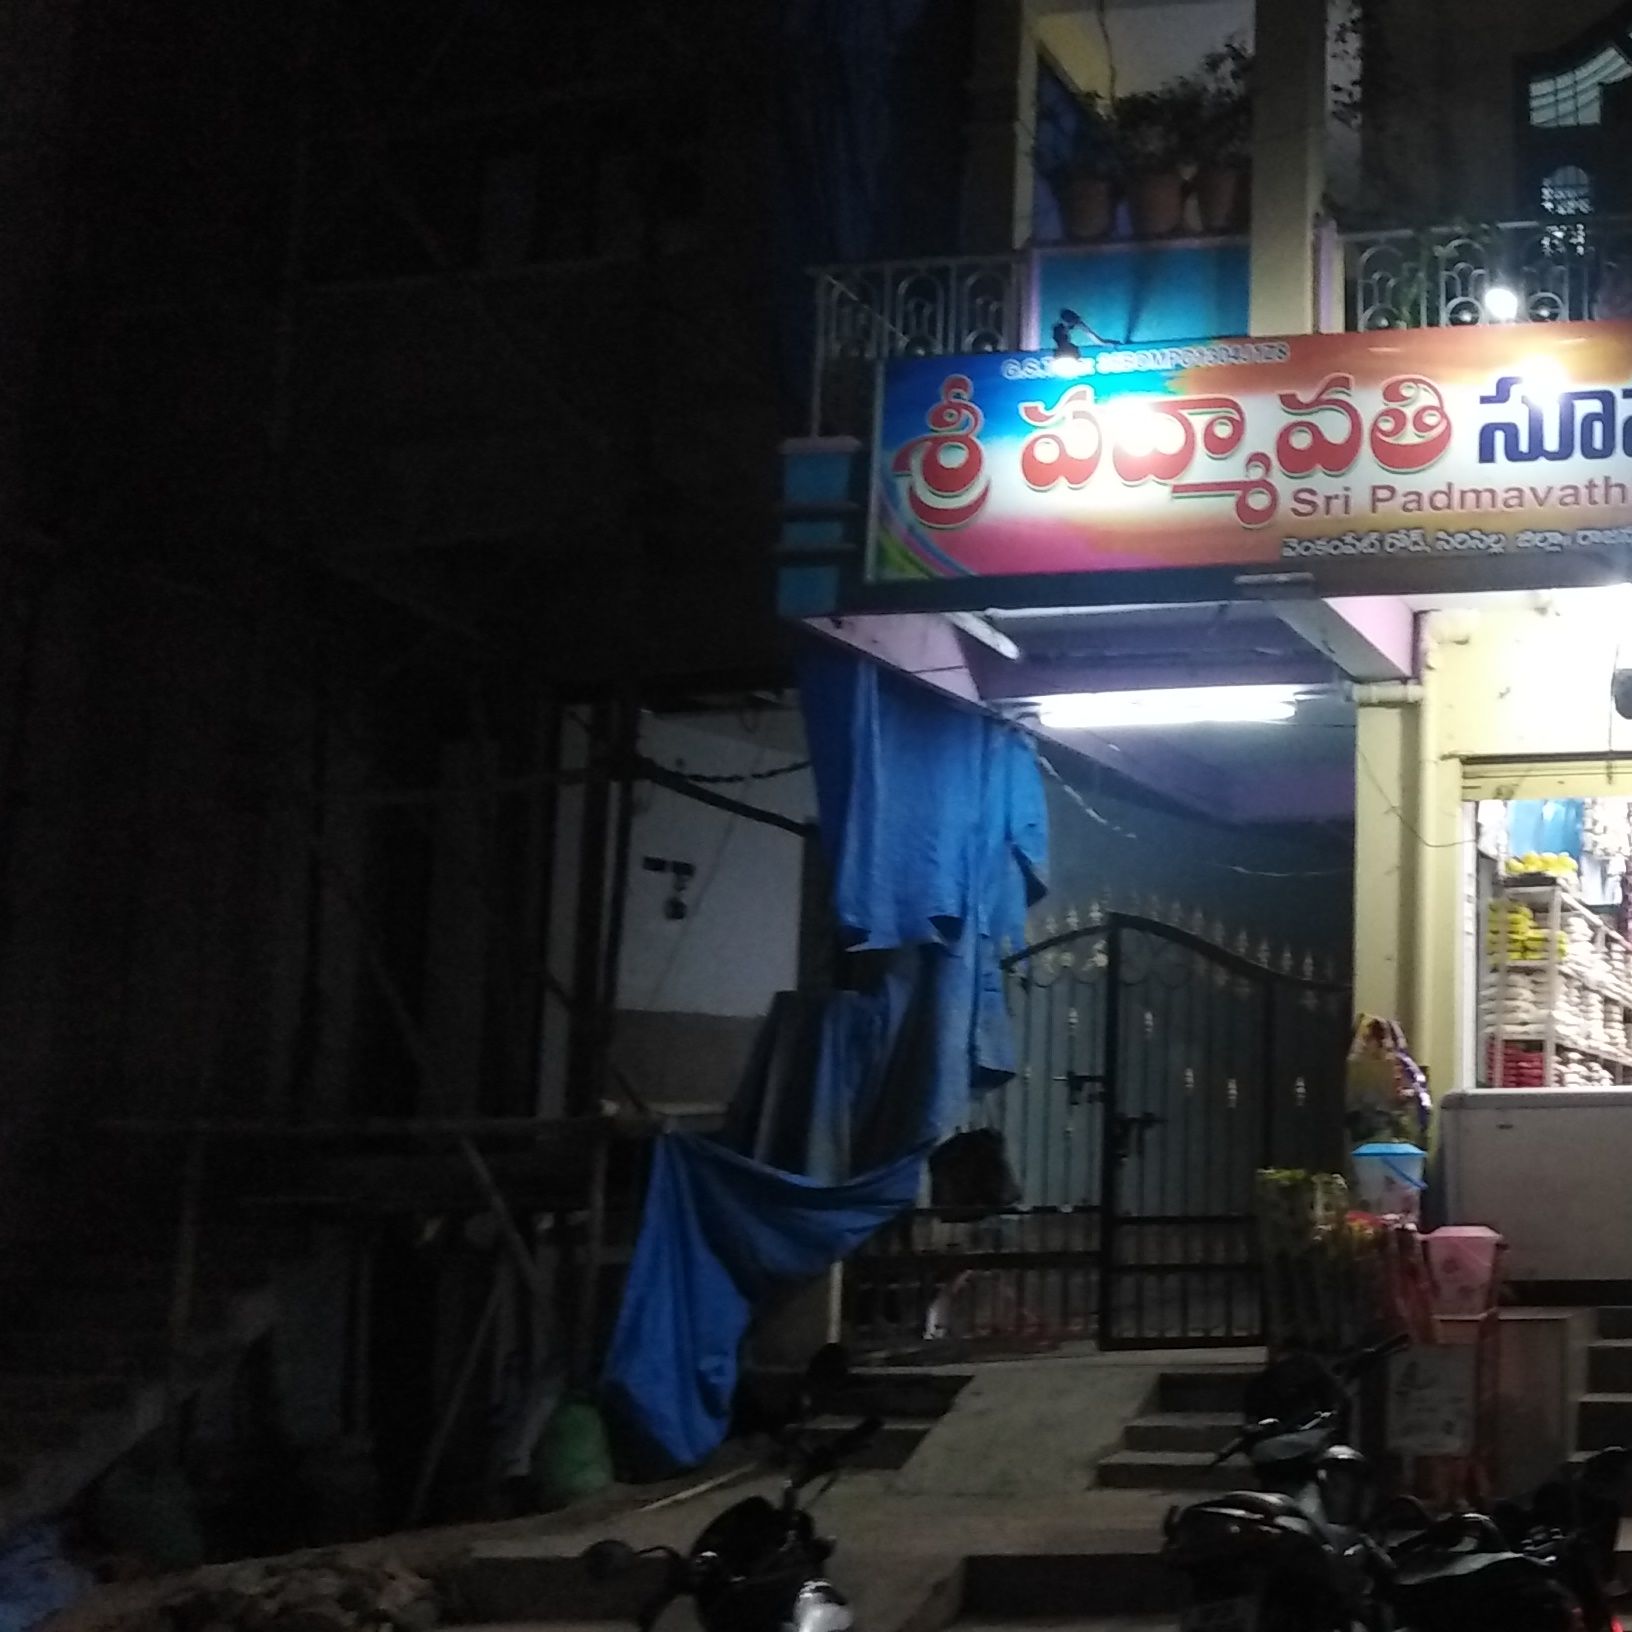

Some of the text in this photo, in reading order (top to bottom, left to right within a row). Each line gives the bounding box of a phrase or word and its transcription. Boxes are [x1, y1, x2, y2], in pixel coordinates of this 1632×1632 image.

[893, 373, 990, 529] శ్రీ
[1019, 373, 1452, 528] పద్మావతి
[1290, 482, 1352, 518] Sri
